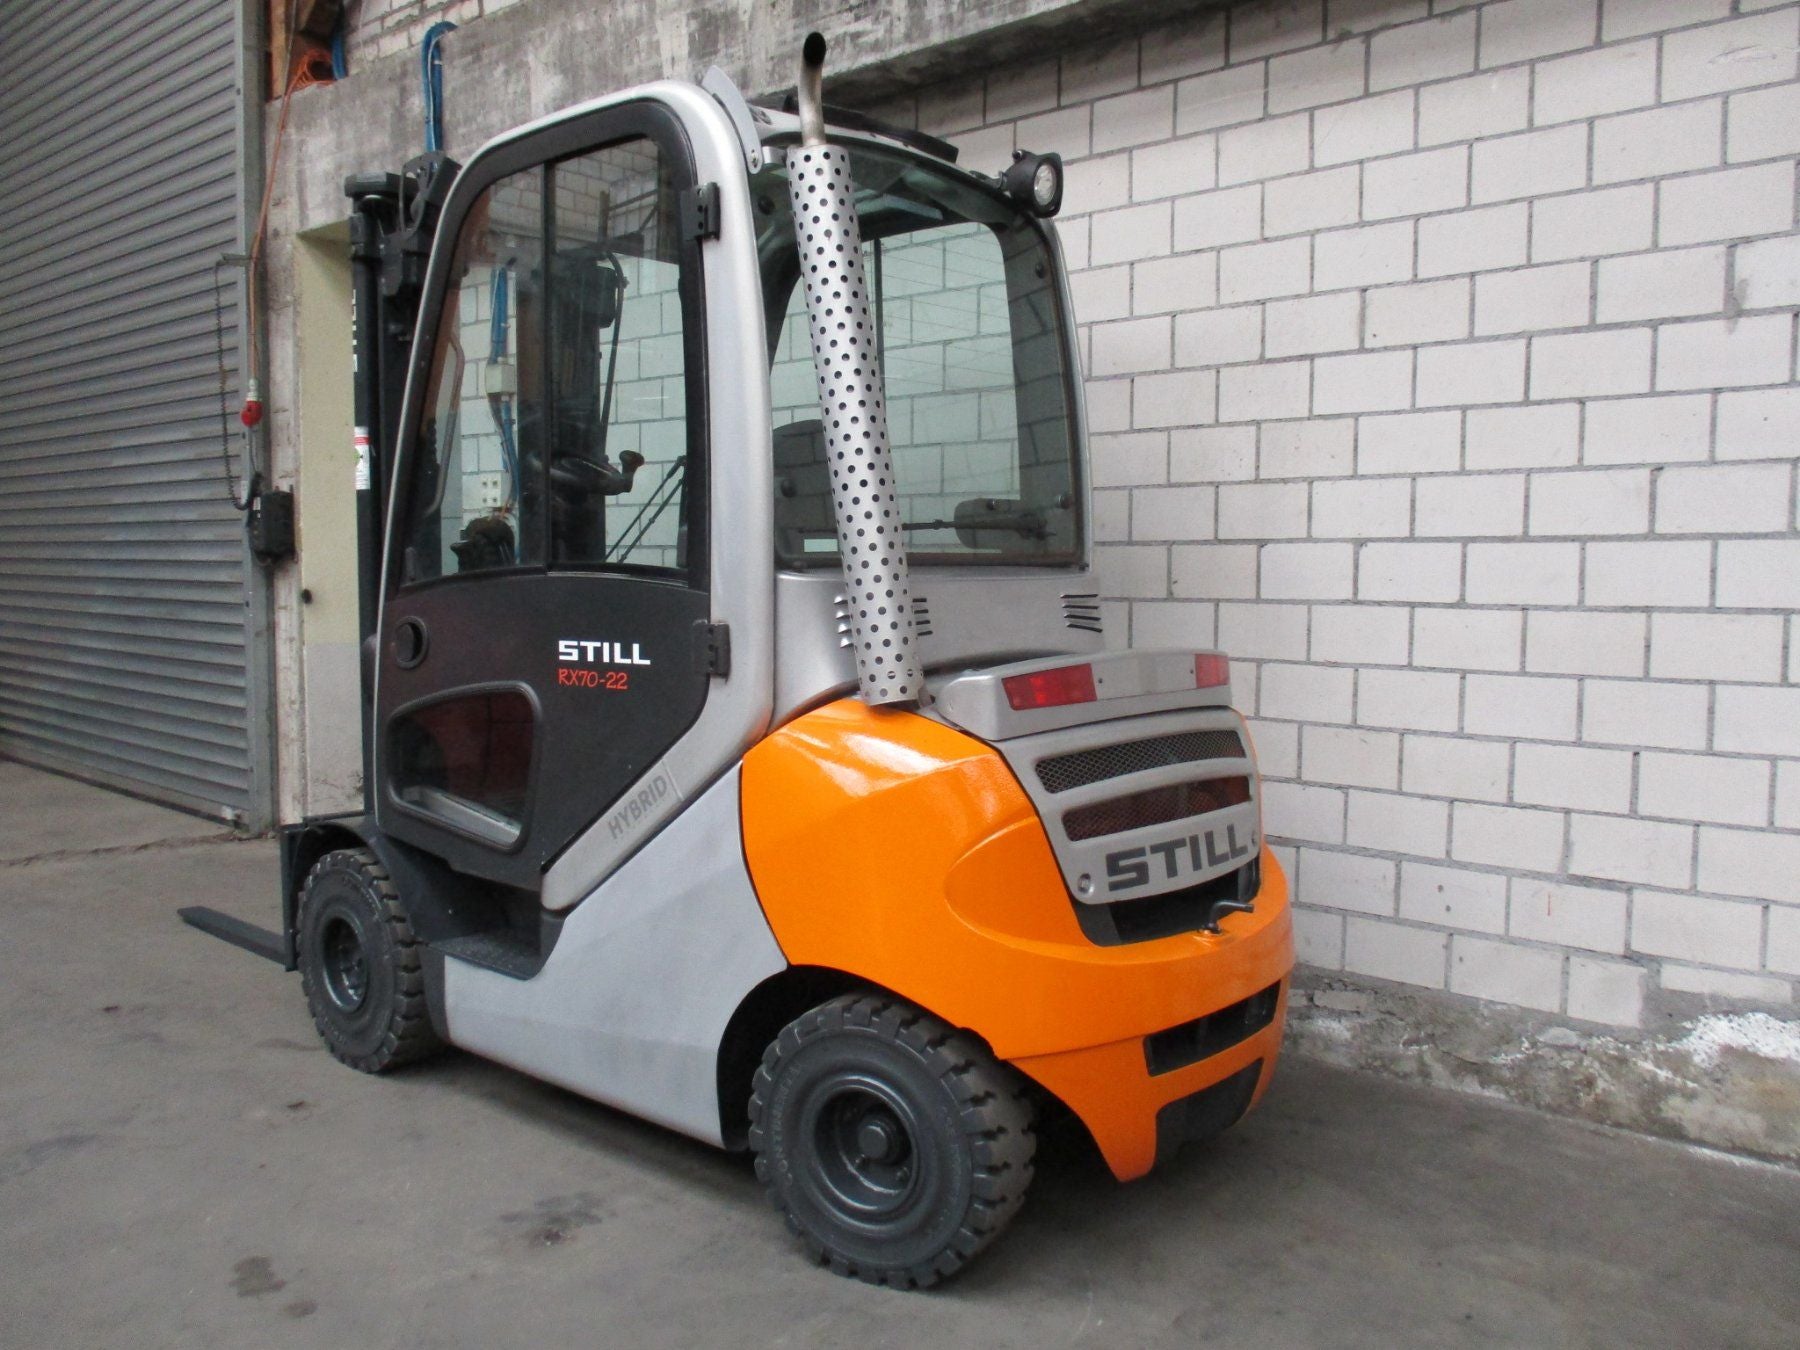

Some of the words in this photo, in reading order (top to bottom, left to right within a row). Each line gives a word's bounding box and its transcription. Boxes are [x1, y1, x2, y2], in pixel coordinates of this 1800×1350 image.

[558, 640, 651, 665] STILL
[558, 668, 628, 690] RX70-22
[608, 775, 667, 839] HYBRID
[1106, 823, 1248, 892] STILL
